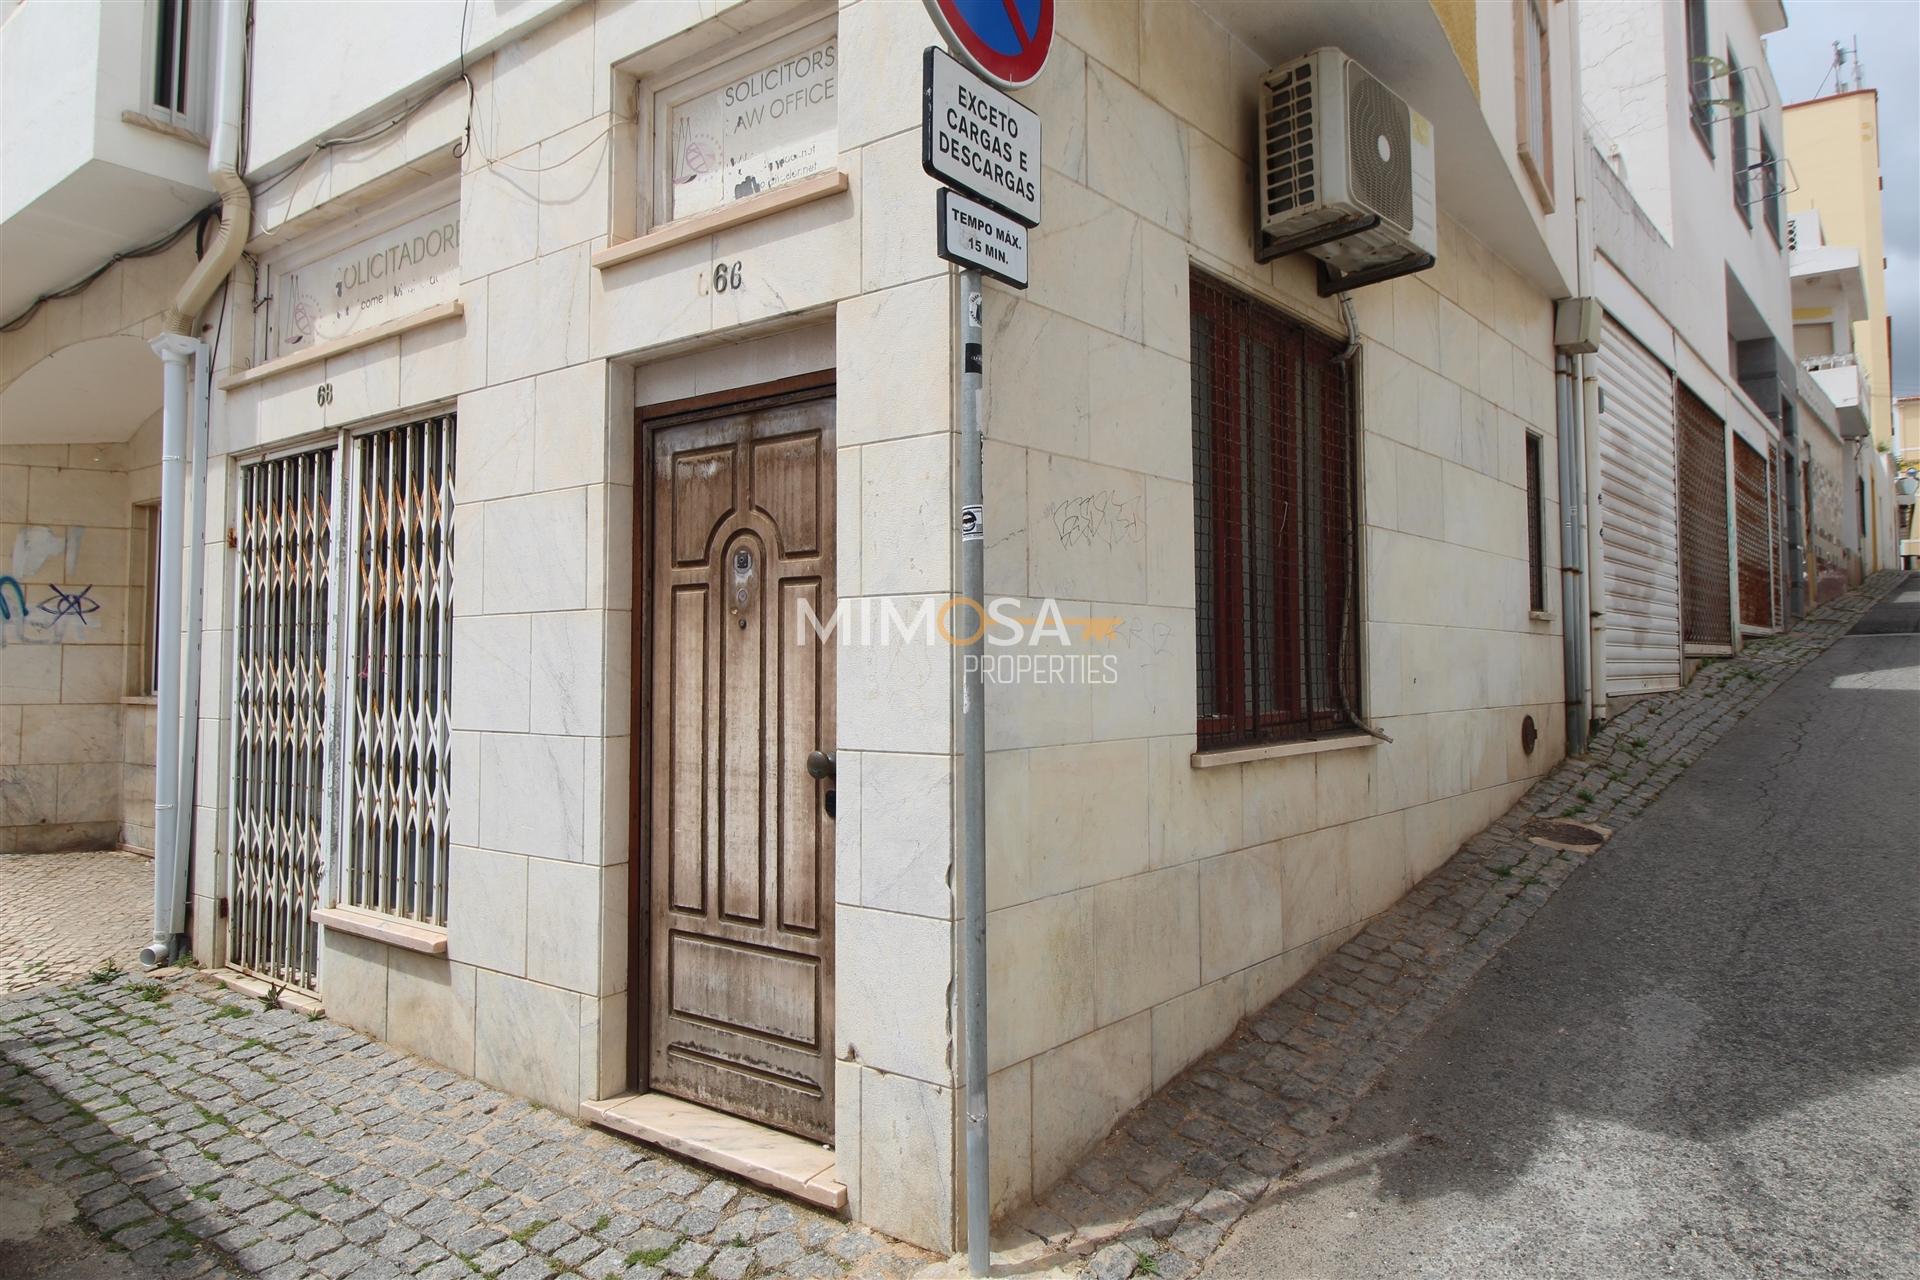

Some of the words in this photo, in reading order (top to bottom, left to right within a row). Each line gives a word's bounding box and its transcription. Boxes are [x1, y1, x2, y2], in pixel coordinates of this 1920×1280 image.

[725, 45, 835, 107] SOLICITORS
[770, 77, 834, 119] OFFICE
[958, 84, 1018, 139] EXCETO
[946, 107, 1012, 163] CARGAS
[1019, 150, 1028, 172] E
[939, 130, 1035, 203] DESCARGAS
[951, 207, 993, 236] TEMPO
[995, 227, 1022, 250] MÁX.
[968, 237, 982, 253] 15
[985, 243, 1009, 265] MIN.
[713, 260, 742, 293] 66
